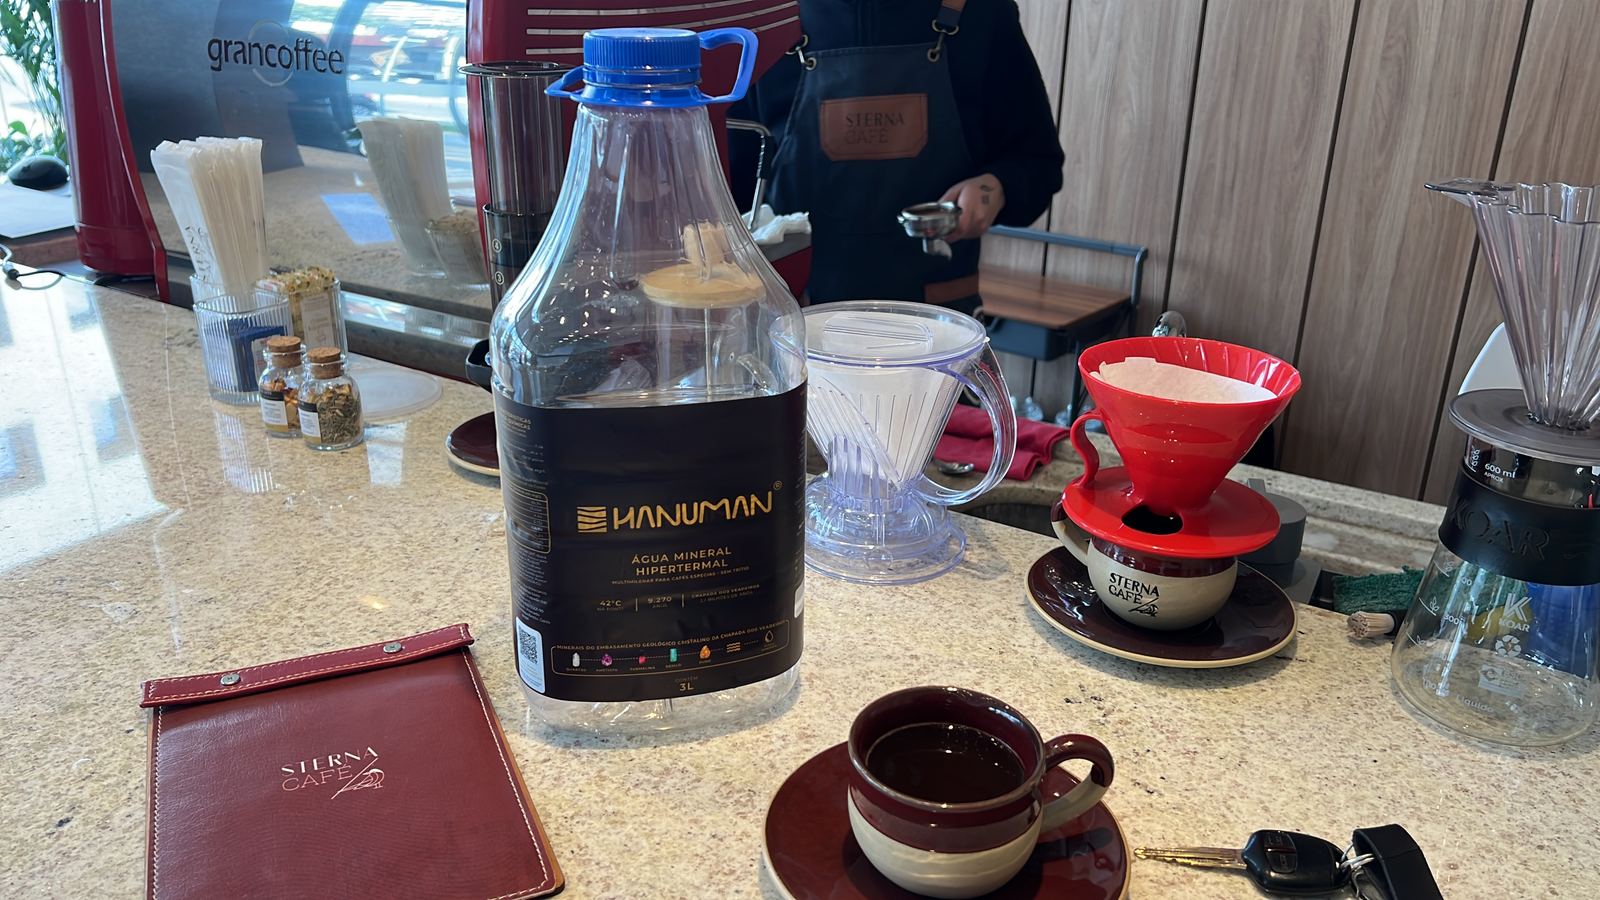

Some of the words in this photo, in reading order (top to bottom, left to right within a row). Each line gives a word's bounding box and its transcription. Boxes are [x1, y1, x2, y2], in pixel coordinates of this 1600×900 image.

[207, 38, 344, 74] grancoffee
[845, 111, 905, 128] STERNA
[1484, 463, 1501, 474] 600
[1502, 470, 1516, 479] ml
[613, 490, 773, 530] HANUMAN
[631, 554, 669, 564] ÁGUA
[674, 546, 732, 561] MINERAL
[636, 559, 729, 576] HIPERTERMAL
[1109, 572, 1160, 597] STERNA
[600, 599, 622, 607] 42°C
[677, 637, 710, 646] CRISTALINO
[720, 630, 746, 639] CHAPADA
[679, 682, 694, 692] 3L
[281, 746, 379, 777] STERNA
[281, 763, 353, 791] CAFÉ
